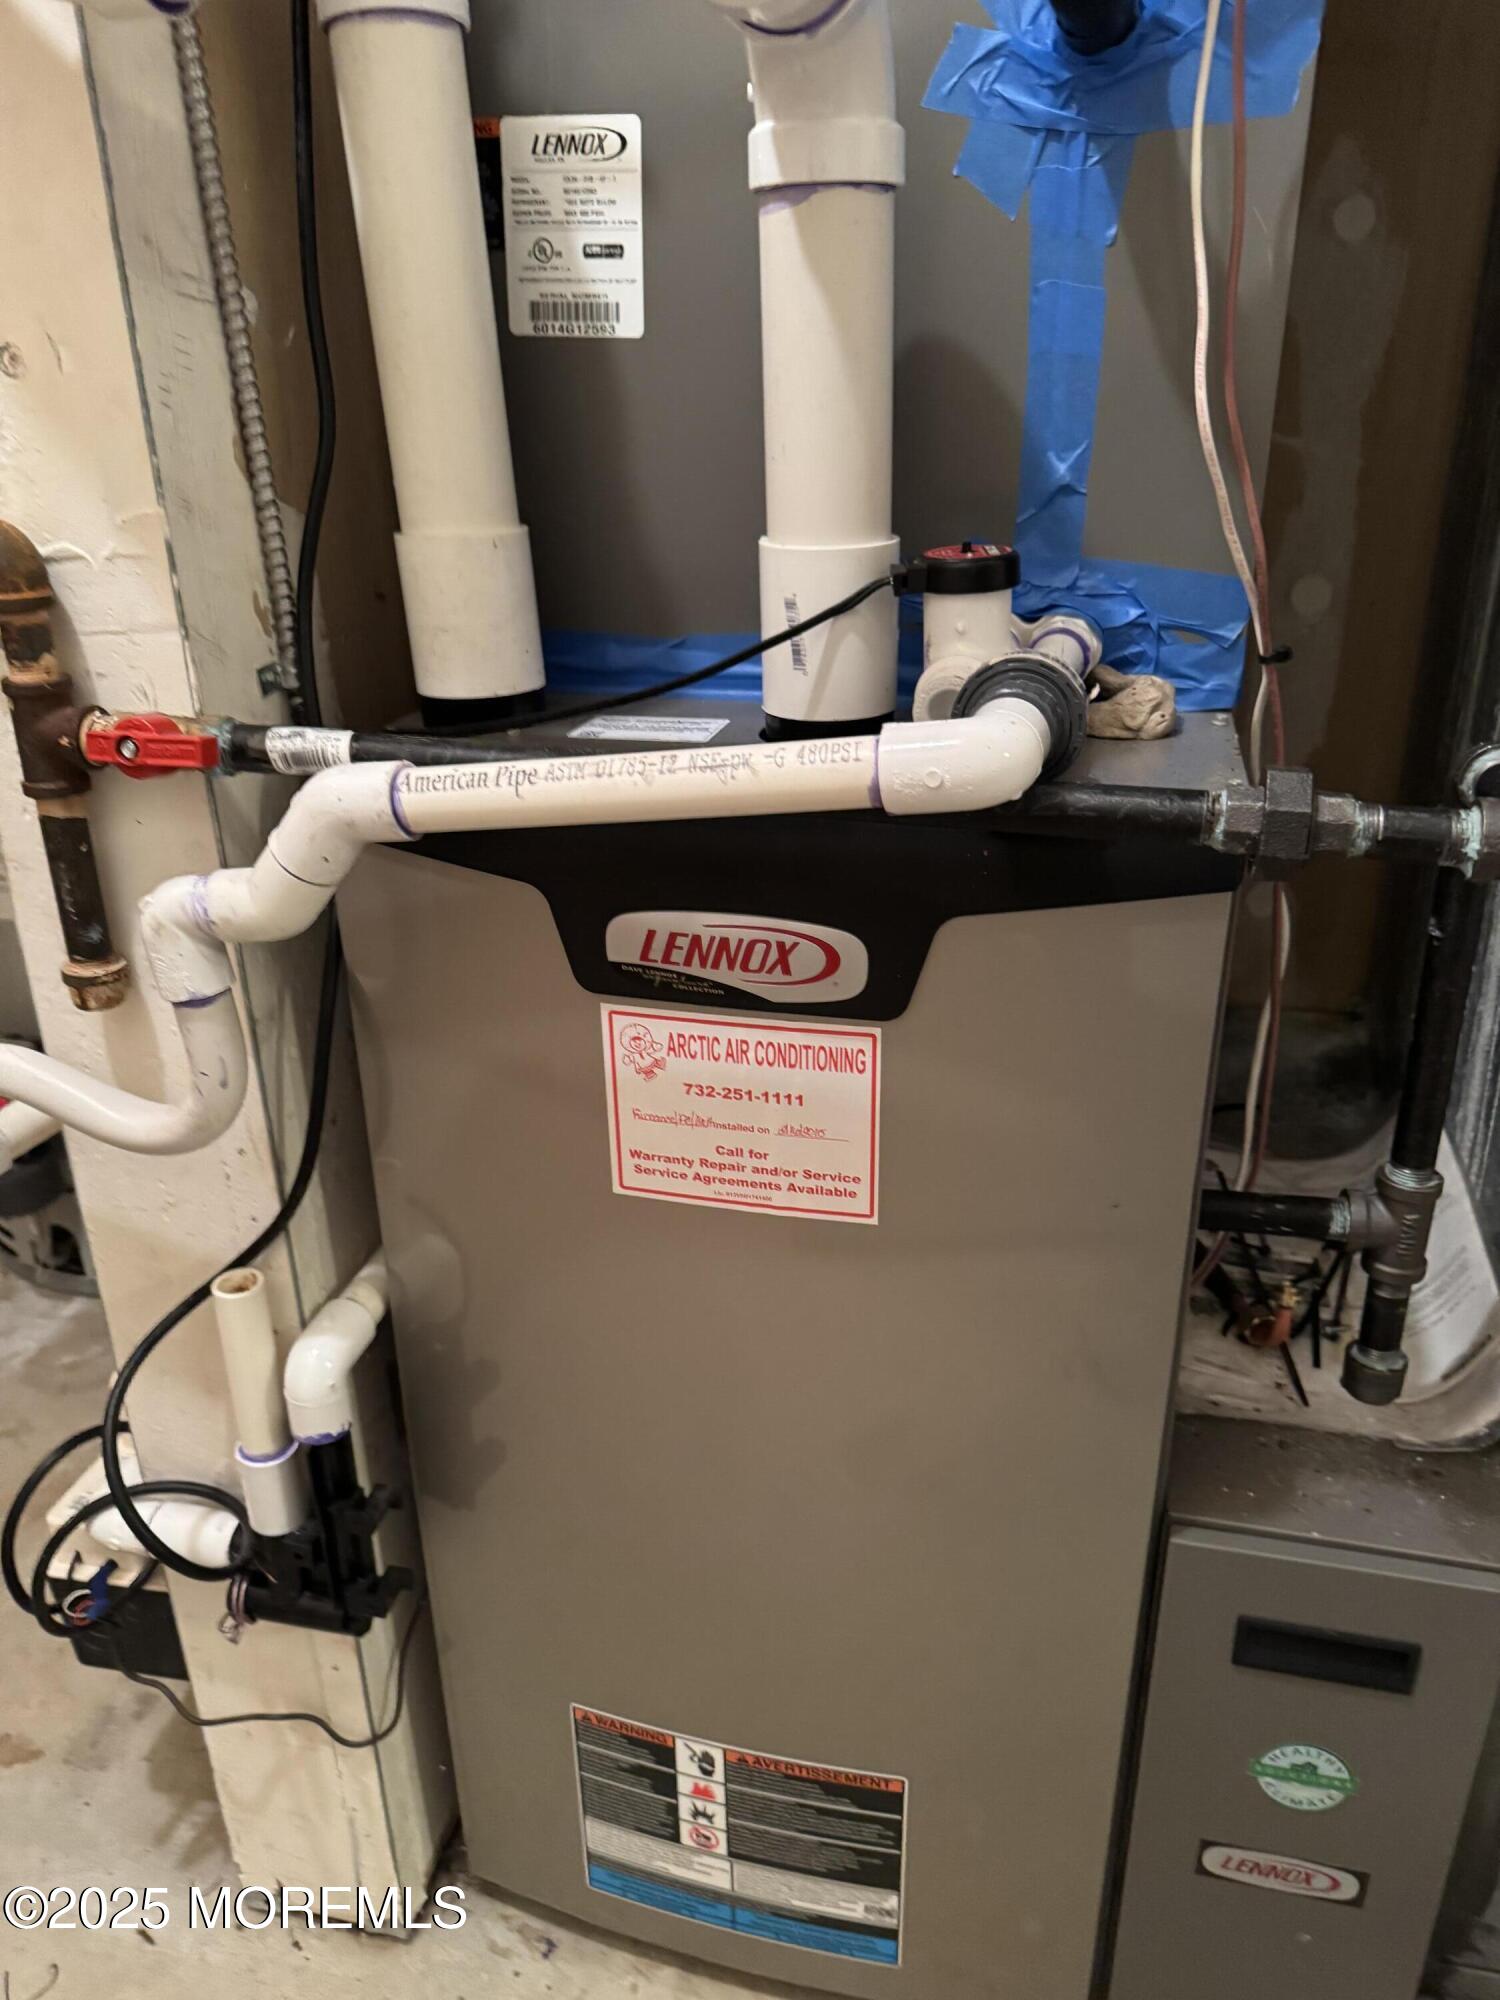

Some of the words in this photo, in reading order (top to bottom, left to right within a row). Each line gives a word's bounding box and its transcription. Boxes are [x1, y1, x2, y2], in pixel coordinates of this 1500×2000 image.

[531, 133, 608, 156] LENNOX
[399, 769, 489, 795] American
[496, 765, 538, 799] Pipe
[798, 740, 863, 766] 480PSI
[639, 929, 800, 977] LENNOX
[667, 1031, 721, 1062] ARCTIC
[725, 1038, 751, 1066] AIR
[754, 1041, 867, 1075] CONDITIONING
[683, 1082, 804, 1107] 732-251-1111
[757, 1126, 770, 1135] on
[629, 1148, 694, 1169] Warranty
[699, 1157, 747, 1174] Repair
[751, 1165, 798, 1179] and/or
[802, 1168, 862, 1185] Service
[715, 1145, 744, 1158] Call
[748, 1148, 769, 1161] for
[633, 1163, 688, 1181] Service
[692, 1172, 782, 1192] Agreements
[787, 1182, 858, 1199] Available
[595, 1714, 668, 1745] WARNING
[752, 1755, 890, 1790] AVERTISSEMENT
[1220, 1856, 1313, 1887] LENNOX
